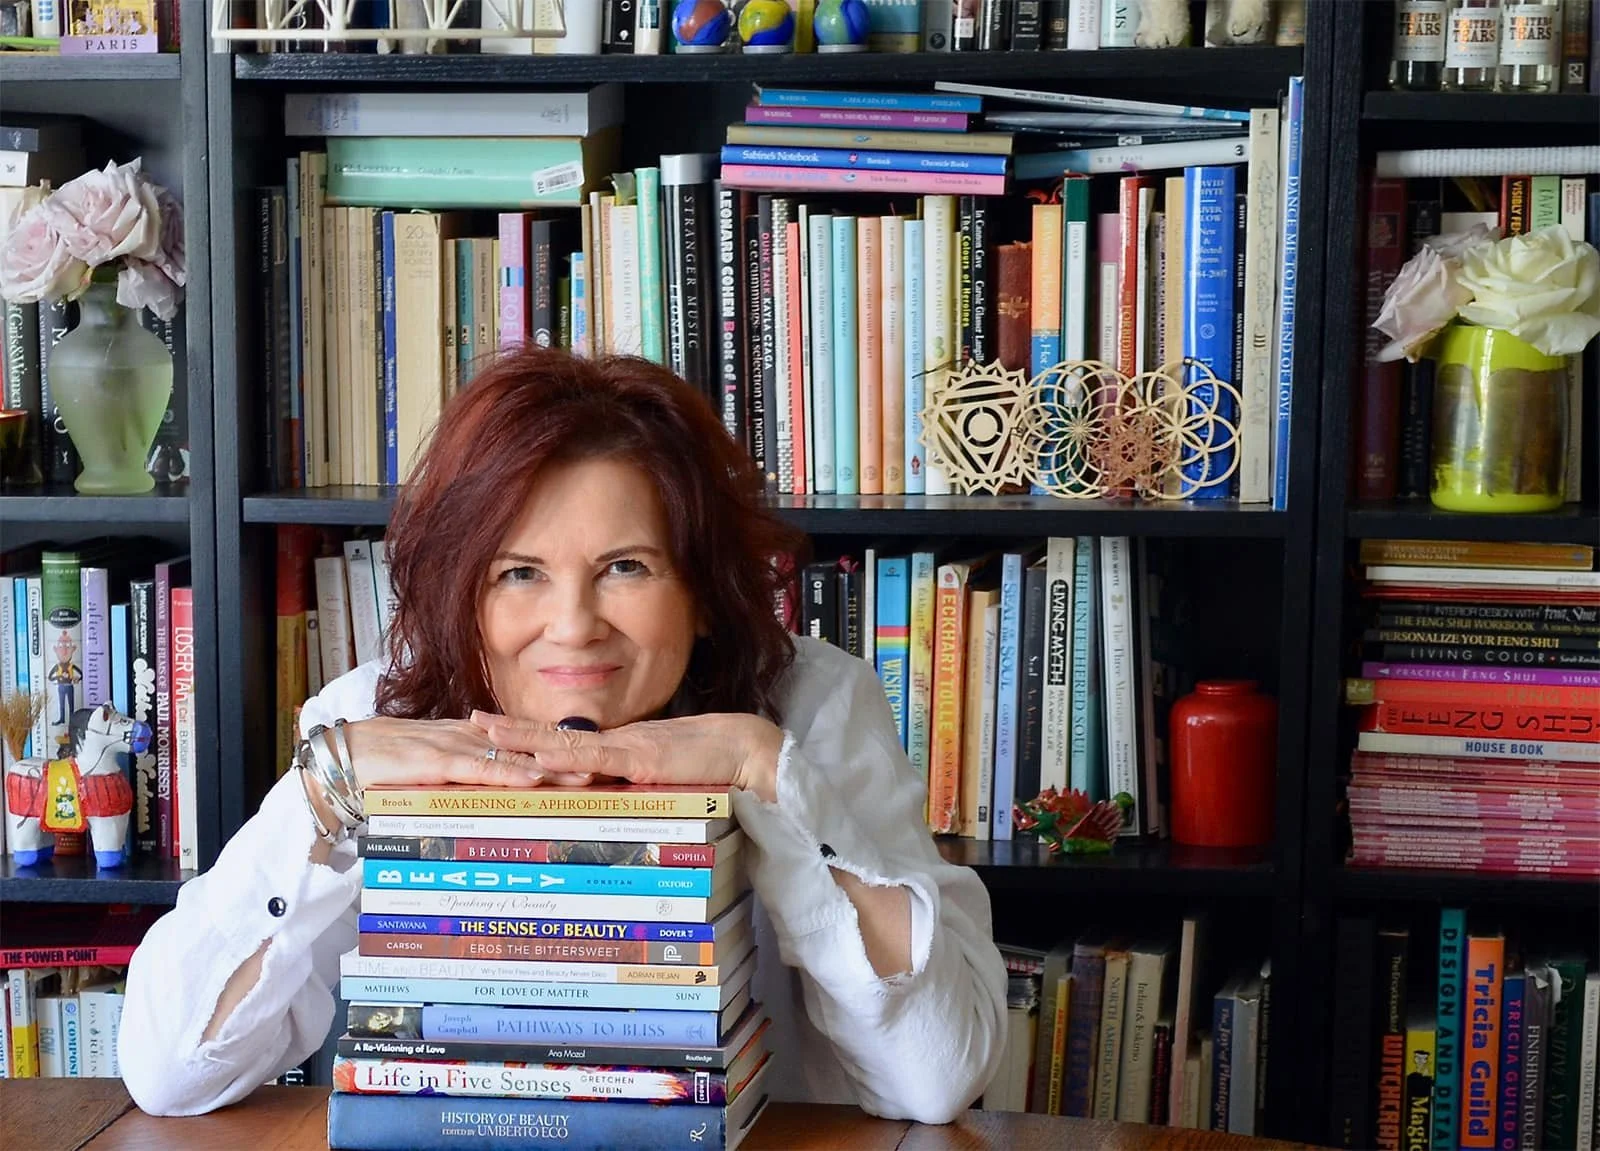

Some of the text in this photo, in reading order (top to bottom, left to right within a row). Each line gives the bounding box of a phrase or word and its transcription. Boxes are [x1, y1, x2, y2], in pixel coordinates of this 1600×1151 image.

[1454, 29, 1496, 43] TEARS
[1510, 26, 1552, 40] TEARS
[85, 38, 139, 51] PARIS
[777, 151, 819, 163] Notebook
[1511, 181, 1523, 215] VISIBLY
[683, 195, 699, 349] STRANGER MUSIC
[961, 215, 972, 328] The Colours of Heroines
[719, 190, 737, 380] LEONARD COHEN Book of
[761, 232, 774, 370] DUNK TANK KAYLA CZAGA
[1279, 175, 1299, 421] DANCE ME TO THE END OF LOVE
[1120, 304, 1133, 375] FORBIDDEN
[752, 344, 764, 398] selection
[754, 400, 765, 413] of
[752, 417, 764, 458] poems
[1111, 540, 1120, 561] DAVID
[1112, 563, 1120, 587] WHYTE
[87, 601, 104, 645] after
[1434, 606, 1540, 619] INTERIOR DESIGN WITH
[1050, 583, 1066, 683] LIVING MYTH
[1394, 615, 1535, 632] THE FENG SHUI WORKBOOK
[157, 626, 166, 647] THE
[1000, 583, 1018, 691] SEAT SOUL
[1379, 631, 1560, 649] PERSONALIZE YOUR FENG SHUI
[174, 625, 194, 672] LOSER
[1410, 648, 1545, 663] LIVING COLOR
[157, 647, 166, 675] FILMS
[1073, 561, 1088, 759] THE UNTETHERED SOUL
[157, 675, 167, 690] OF
[1395, 667, 1537, 682] PRACTICAL FENG SHUI
[938, 594, 957, 778] ECKHART TOLLE NEW
[156, 691, 169, 725] PAUL
[178, 707, 188, 724] Cat
[911, 671, 925, 770] THE POWER OF
[1400, 709, 1505, 732] FENG
[1465, 741, 1544, 756] HOUSE BOOK
[156, 725, 170, 801] MORRISSEY
[381, 798, 677, 812] Brooks AWAKENING APHRODITE'S LIGHT
[366, 843, 707, 862] MIRAVALLE BEAUTY SOPHIA
[376, 869, 694, 889] BEAUTY OXFORD
[439, 895, 494, 912] Speaking
[495, 898, 509, 912] of
[511, 895, 558, 912] Beauty
[377, 920, 687, 938] SANTAYANA THE SENSE OF BEAUTY DOVER
[3, 949, 99, 964] THE POWER POINT
[386, 941, 621, 958] CARSON EROS THE BITTERSWEET
[627, 971, 681, 981] ADRIAN BEJAN
[364, 984, 702, 1001] MATHEWS FOR LOVE OF MATTER SUNY
[1136, 982, 1149, 1012] Indian
[1438, 927, 1459, 1076] DESIGN AND
[437, 1024, 479, 1036] Campbell
[444, 1014, 473, 1025] Joseph
[496, 1020, 666, 1037] PATHWAYS TO BLISS
[1103, 977, 1121, 1088] NORTH AMERICAN
[1218, 1026, 1232, 1047] Joy
[353, 1042, 362, 1052] A
[362, 1043, 414, 1055] Re-Visioning
[415, 1044, 425, 1054] of
[425, 1044, 446, 1055] Love
[548, 1049, 563, 1058] Ana
[685, 1054, 713, 1063] Routledge
[1131, 1025, 1145, 1062] Eskimo
[1467, 963, 1495, 1138] Tricia Guild
[1503, 999, 1521, 1133] TRICIA GUILD
[1524, 1024, 1541, 1100] FINISHING
[367, 1066, 572, 1093] Life in Five Senses
[580, 1075, 635, 1085] GRETCHEN
[591, 1085, 623, 1095] RUBIN
[1580, 1059, 1595, 1145] SHORTCUTS TO
[441, 1111, 570, 1127] HISTORY OF BEAUTY
[442, 1126, 569, 1138] EDITED BY UMBERTO ECO
